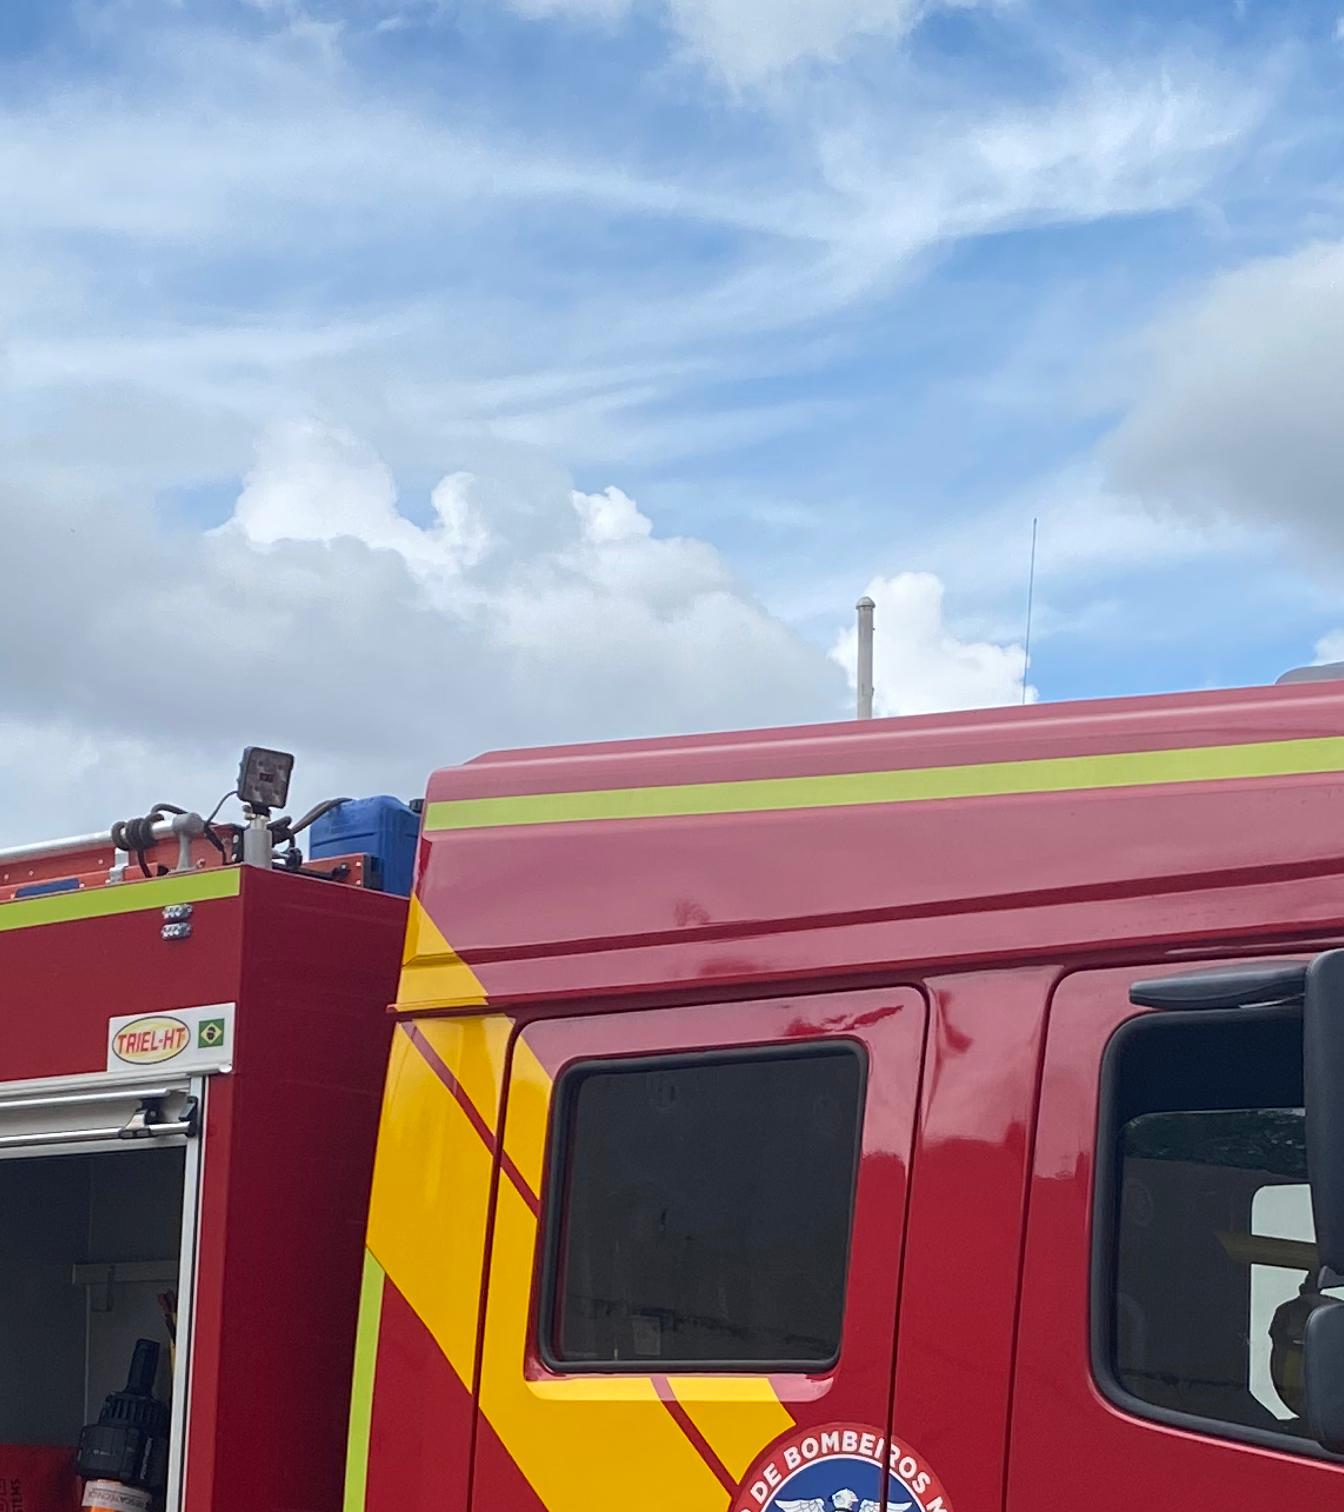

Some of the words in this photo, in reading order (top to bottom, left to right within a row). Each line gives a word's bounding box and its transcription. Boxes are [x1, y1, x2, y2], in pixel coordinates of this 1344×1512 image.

[117, 1027, 186, 1055] TRIEL-HT
[750, 1463, 782, 1504] DE
[783, 1430, 931, 1494] BOMBEIROS
